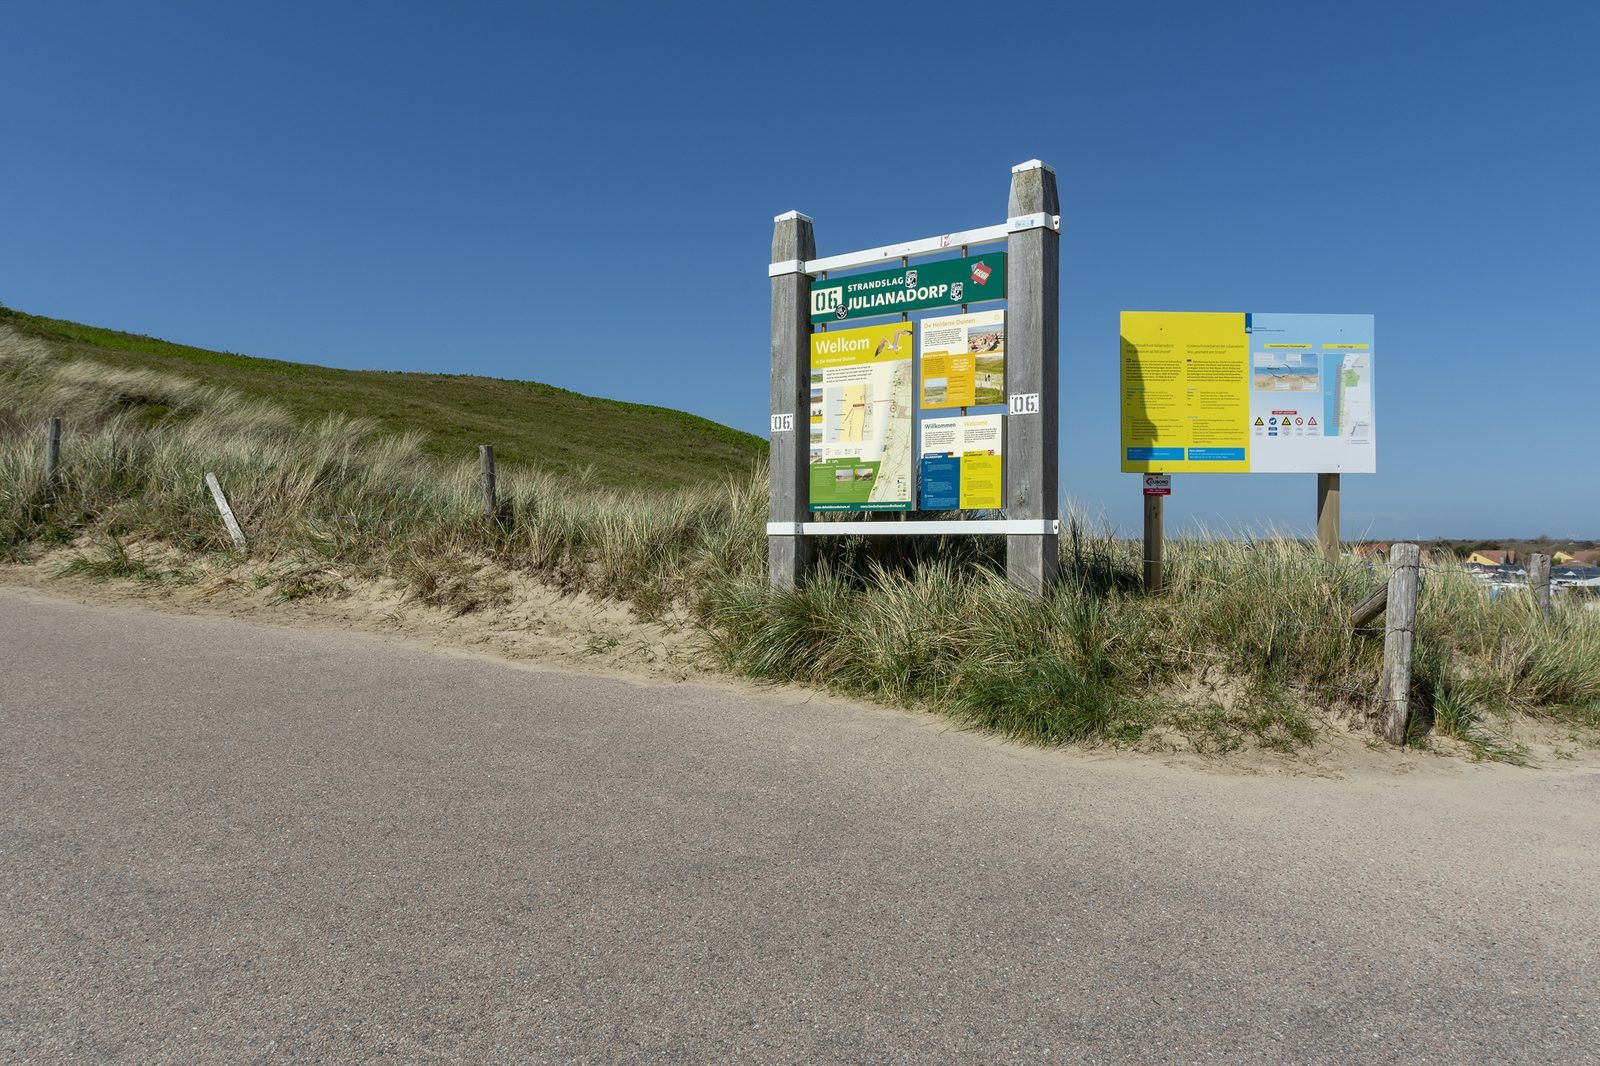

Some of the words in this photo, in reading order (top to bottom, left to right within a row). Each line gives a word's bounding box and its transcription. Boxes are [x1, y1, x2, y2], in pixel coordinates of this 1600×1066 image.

[847, 276, 904, 292] STRANDSLAG
[816, 290, 838, 312] 06
[846, 284, 948, 310] JULIANADORP
[815, 337, 870, 354] Welkom
[1014, 396, 1035, 412] 06
[774, 417, 790, 430] 06
